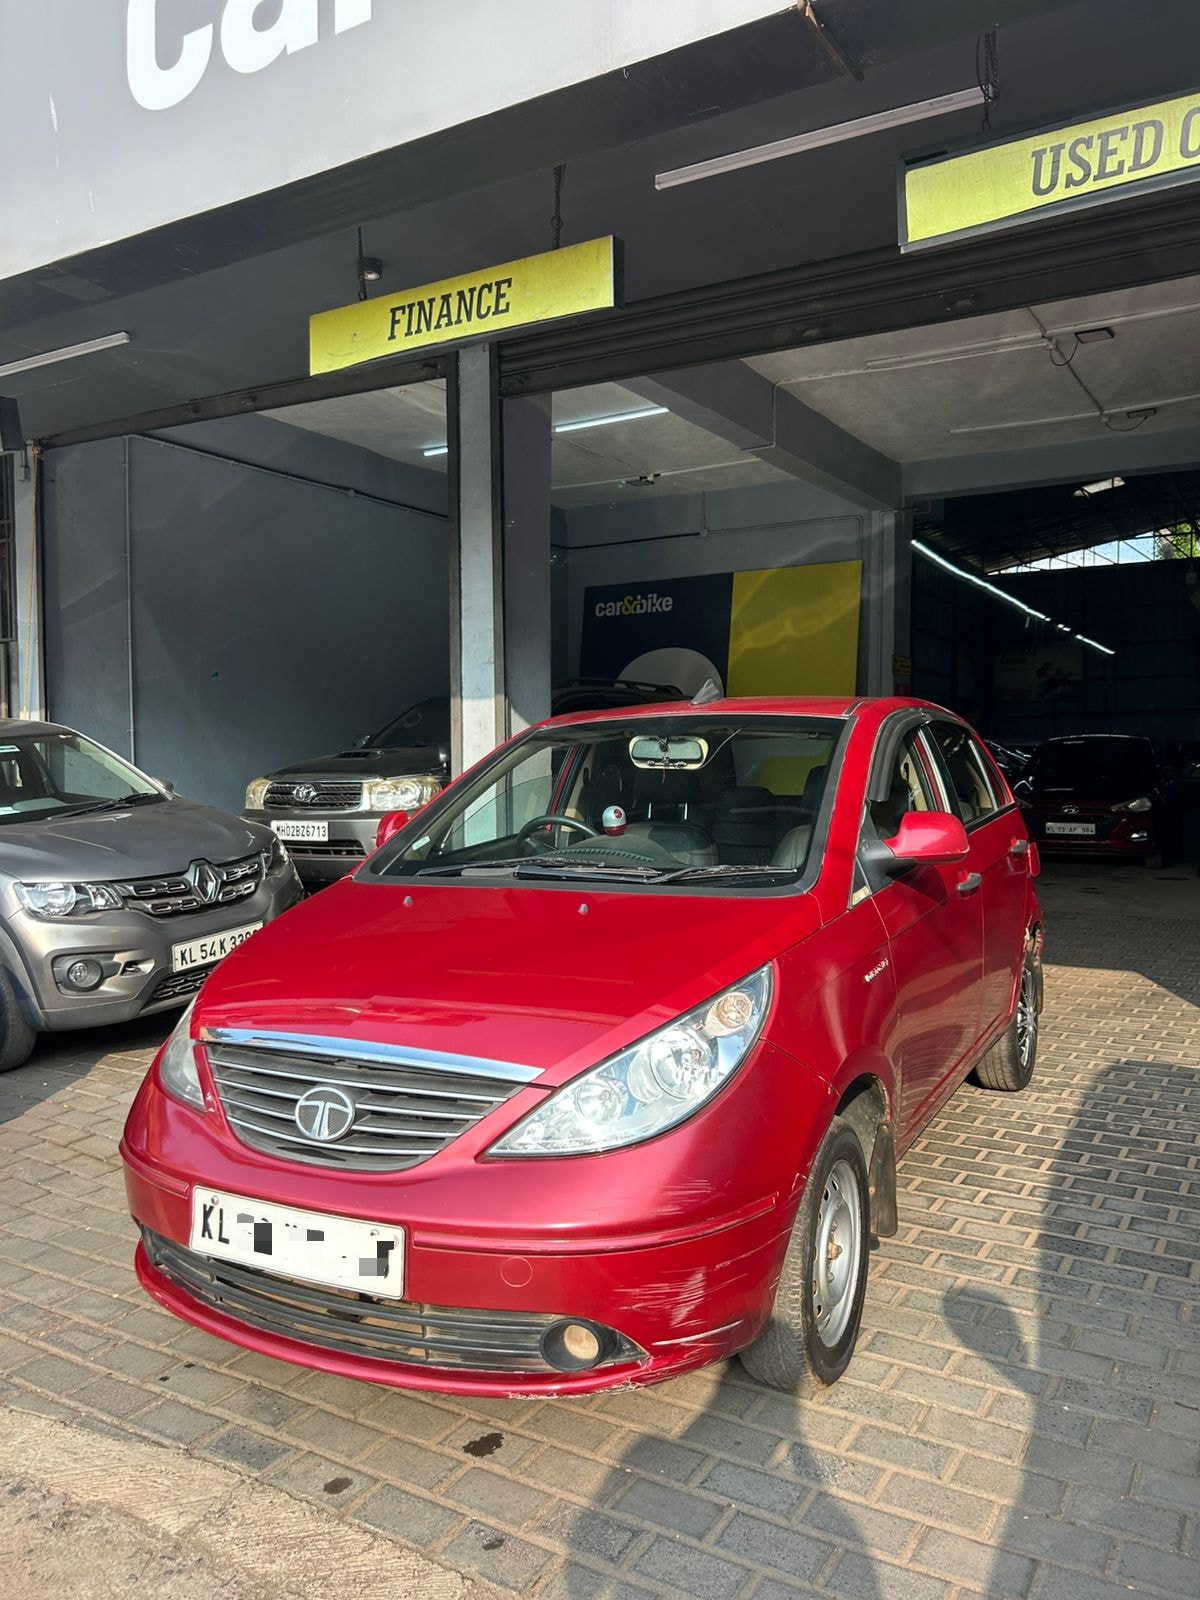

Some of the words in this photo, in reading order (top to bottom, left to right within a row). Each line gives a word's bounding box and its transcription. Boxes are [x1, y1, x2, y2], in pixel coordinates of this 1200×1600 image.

[1031, 119, 1164, 197] USED
[388, 277, 512, 341] FINANCE
[595, 593, 673, 617] car&bike
[180, 947, 197, 966] KL
[200, 941, 217, 959] 54
[219, 938, 227, 955] K
[201, 1203, 230, 1245] KL
